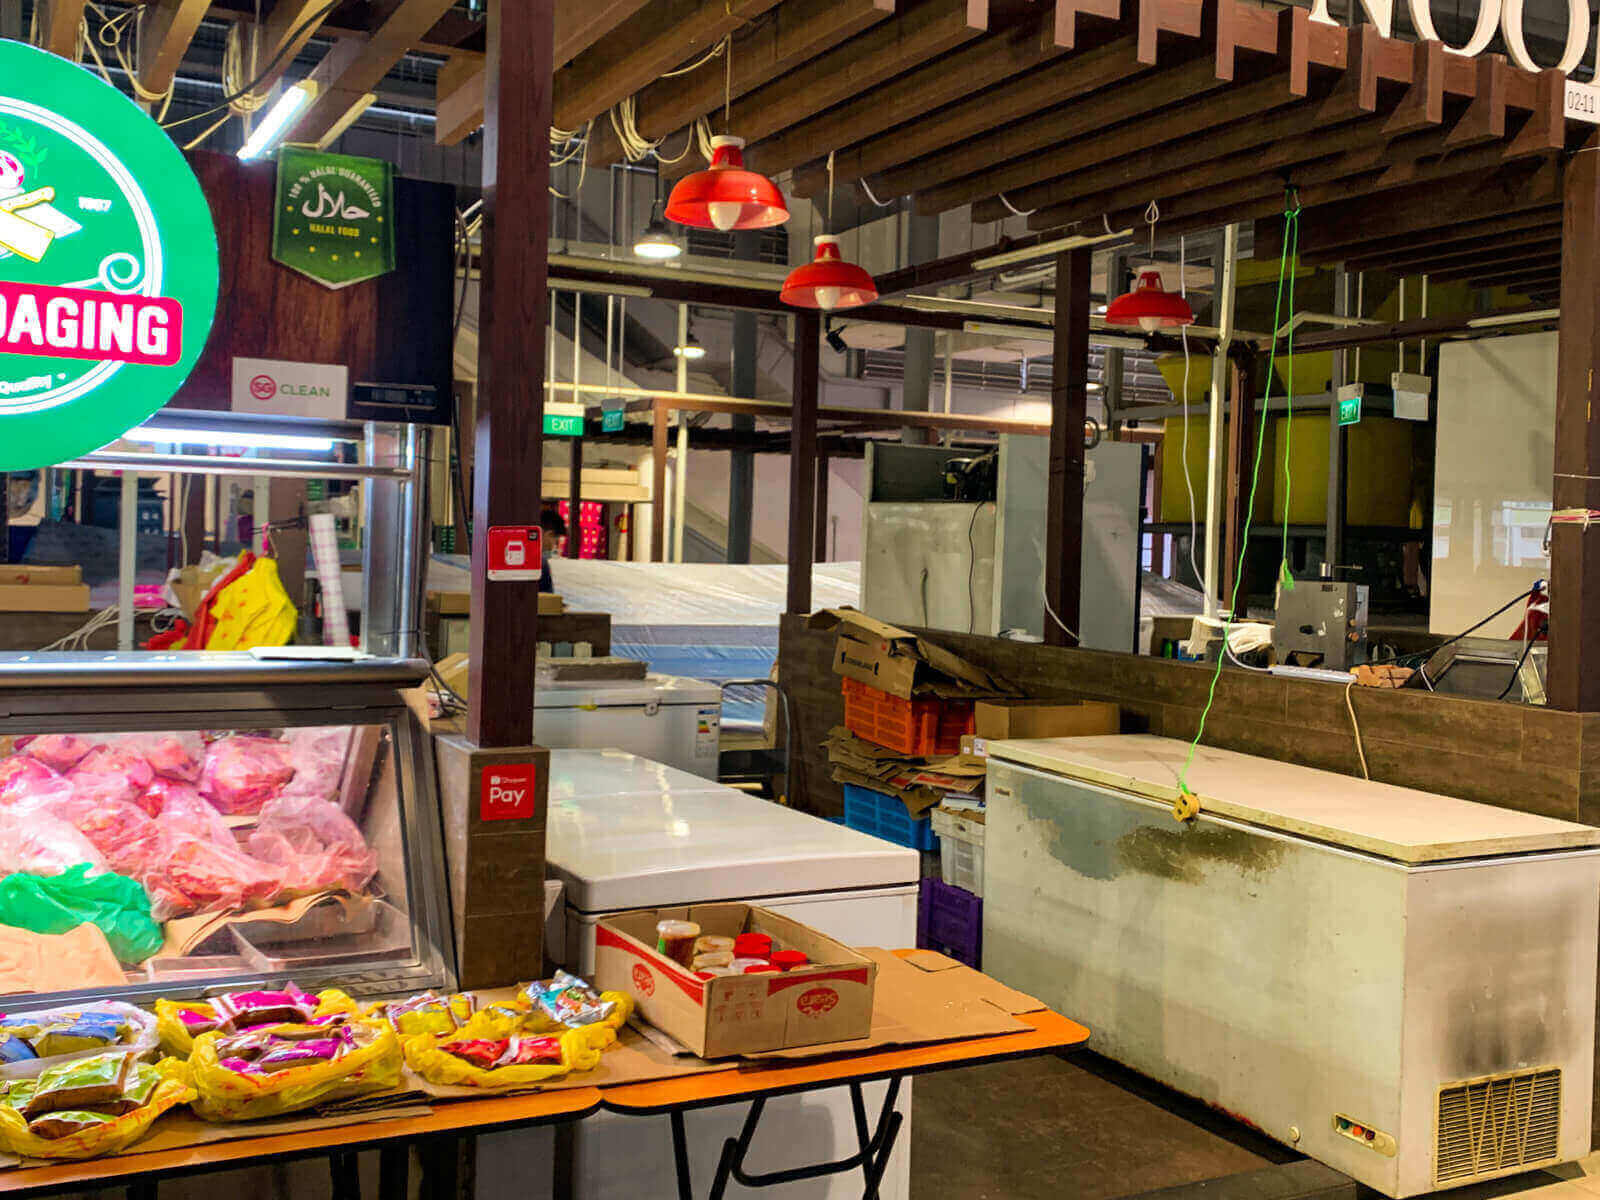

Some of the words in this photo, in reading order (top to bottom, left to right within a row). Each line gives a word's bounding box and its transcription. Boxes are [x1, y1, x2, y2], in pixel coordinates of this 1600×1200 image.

[302, 183, 370, 219] حلال
[0, 293, 169, 356] AGING
[280, 384, 330, 397] CLEAN
[551, 417, 575, 432] EXIT
[489, 786, 526, 807] Pay
